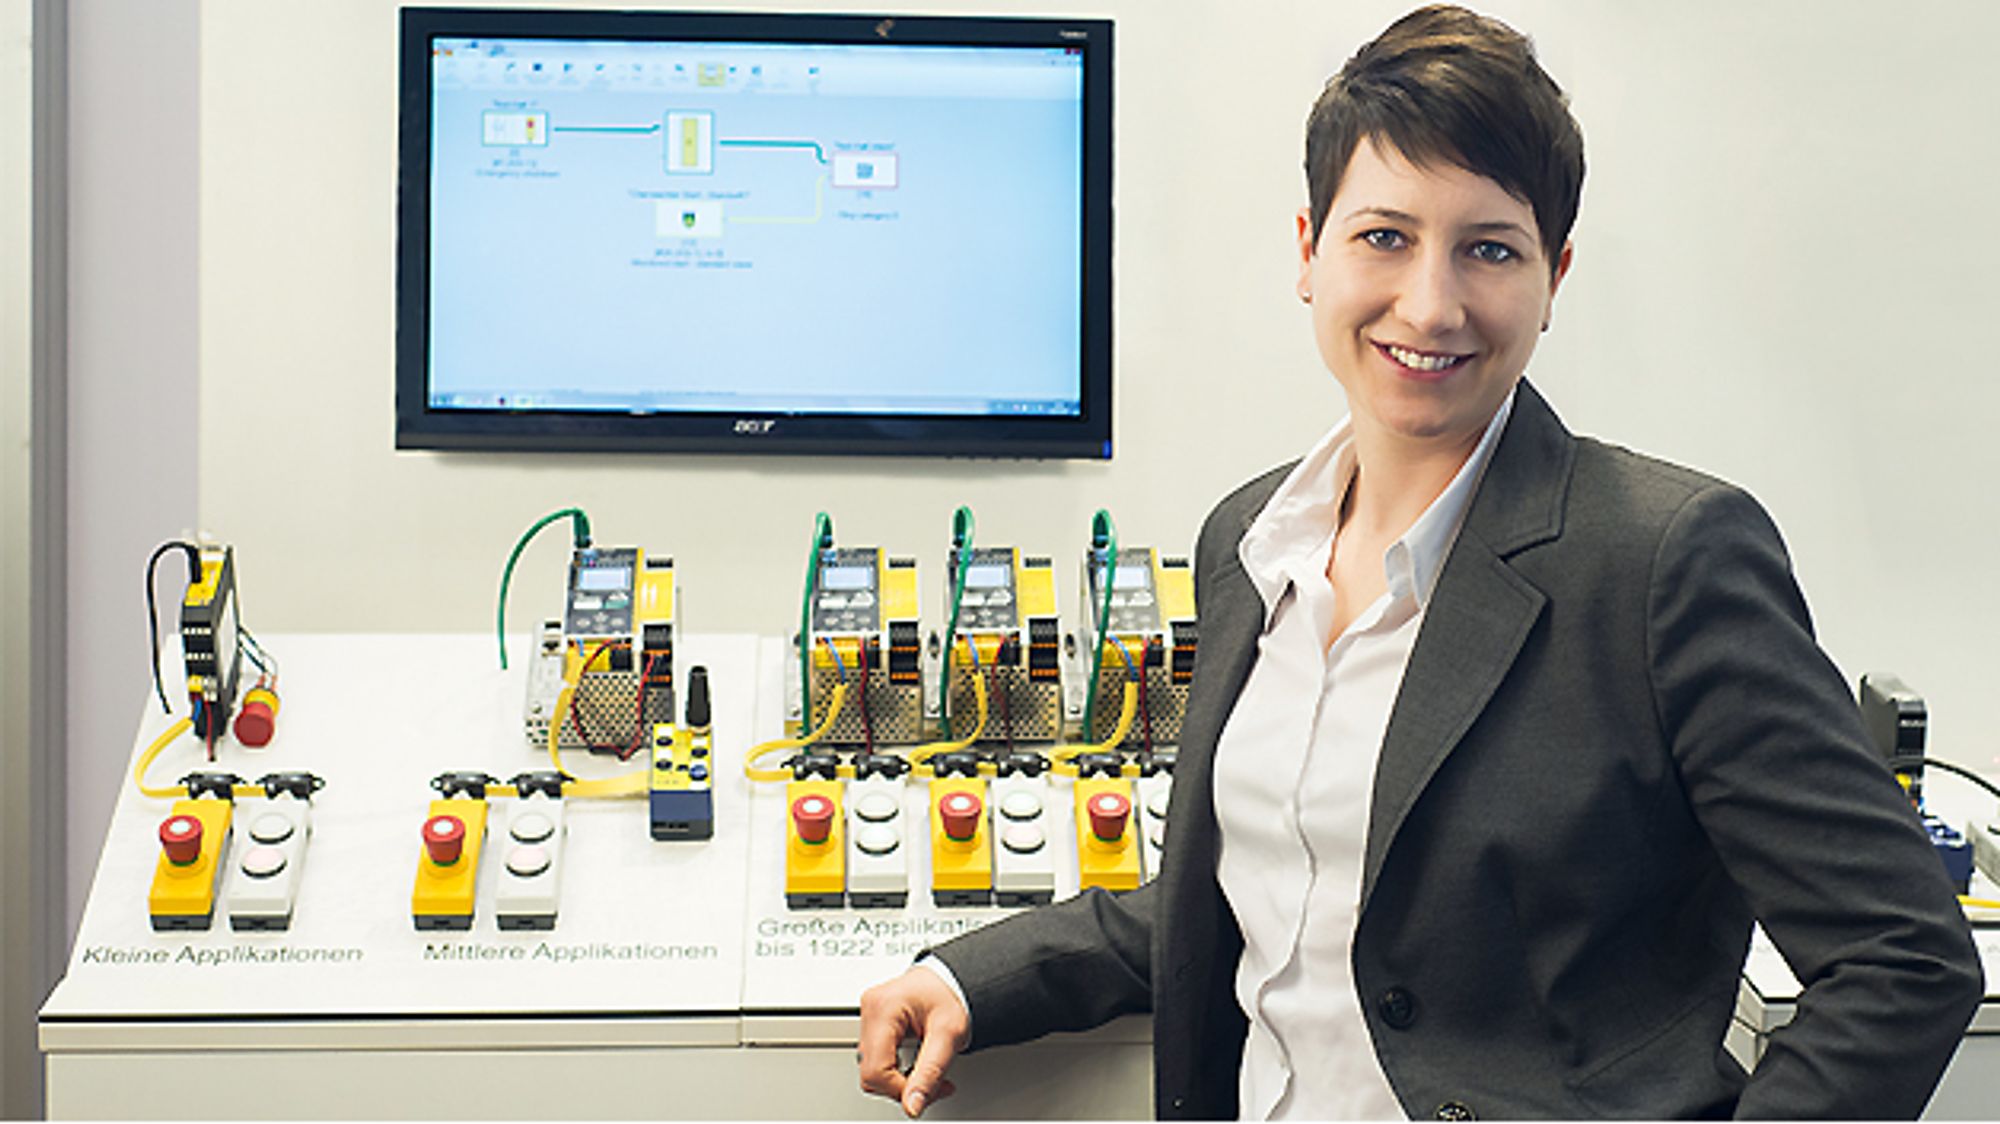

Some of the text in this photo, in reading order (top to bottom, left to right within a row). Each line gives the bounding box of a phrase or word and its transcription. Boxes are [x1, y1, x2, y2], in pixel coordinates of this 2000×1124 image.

[757, 917, 845, 937] Große
[82, 944, 364, 966] Kleine Applikationen
[423, 941, 718, 963] Mittlere Applikationen
[755, 939, 795, 957] bis
[809, 939, 874, 957] 1922
